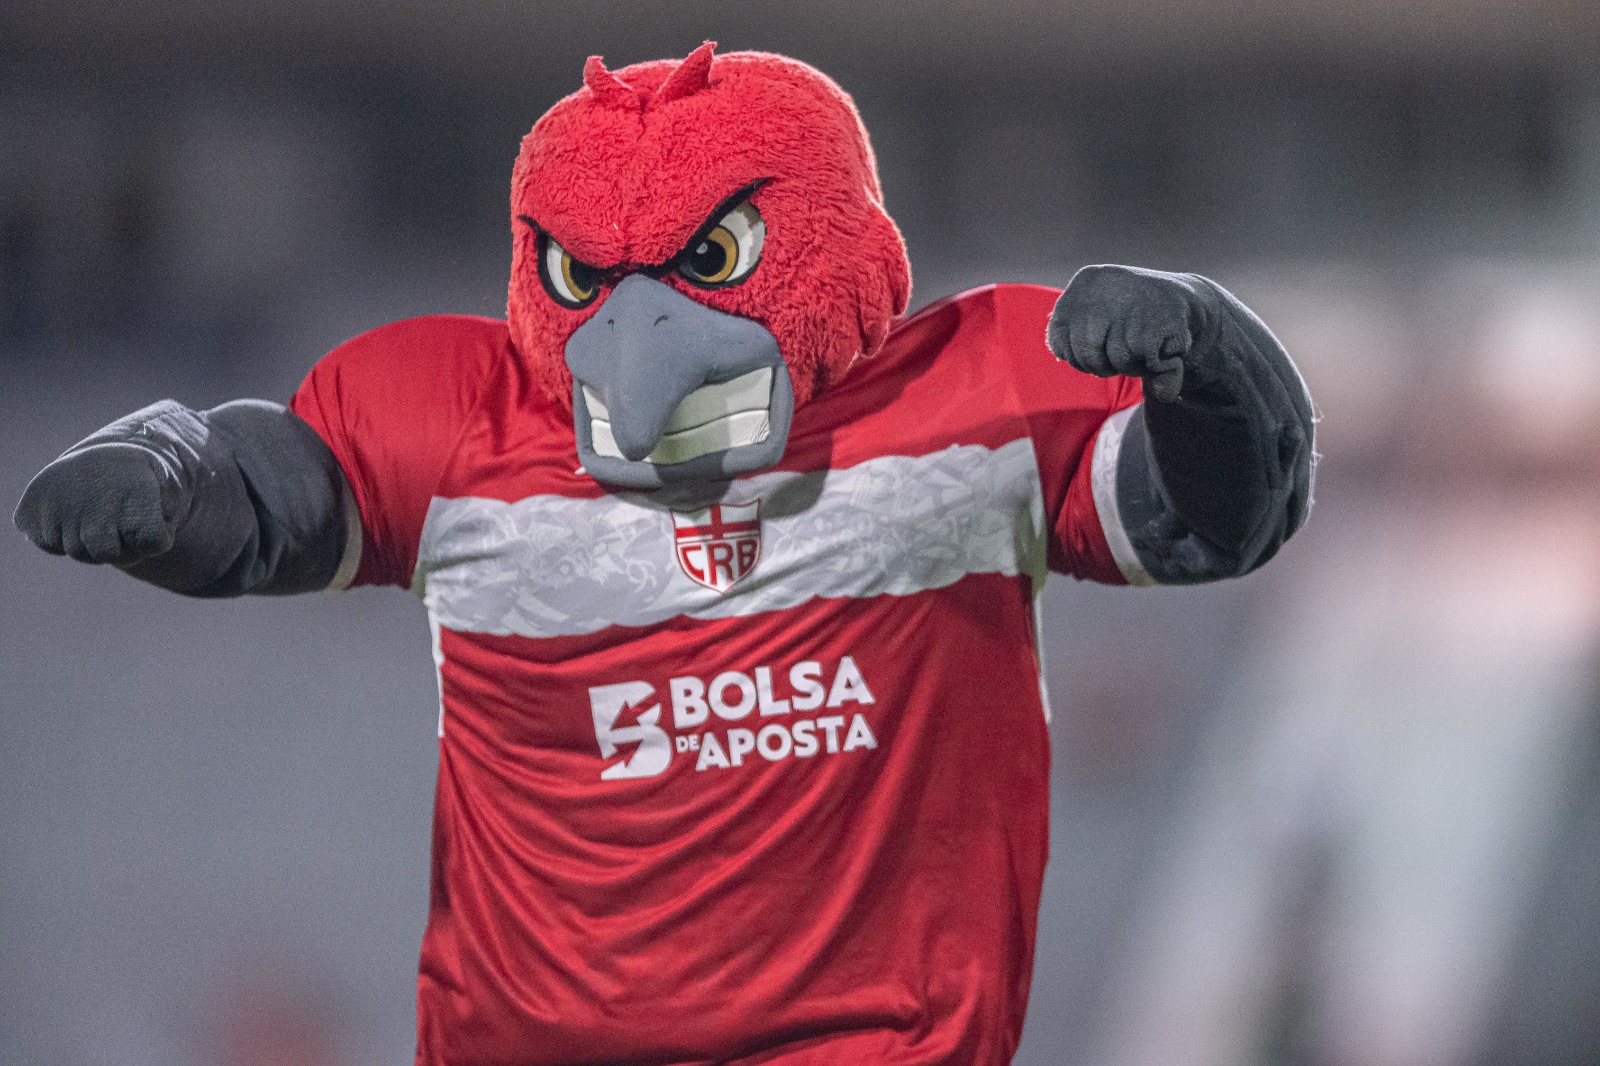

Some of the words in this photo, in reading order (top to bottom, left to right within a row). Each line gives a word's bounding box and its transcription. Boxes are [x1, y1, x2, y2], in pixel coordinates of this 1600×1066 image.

[681, 540, 758, 586] CRB
[669, 656, 875, 728] BOLSA
[675, 734, 699, 753] DE
[695, 713, 878, 771] APOSTA
